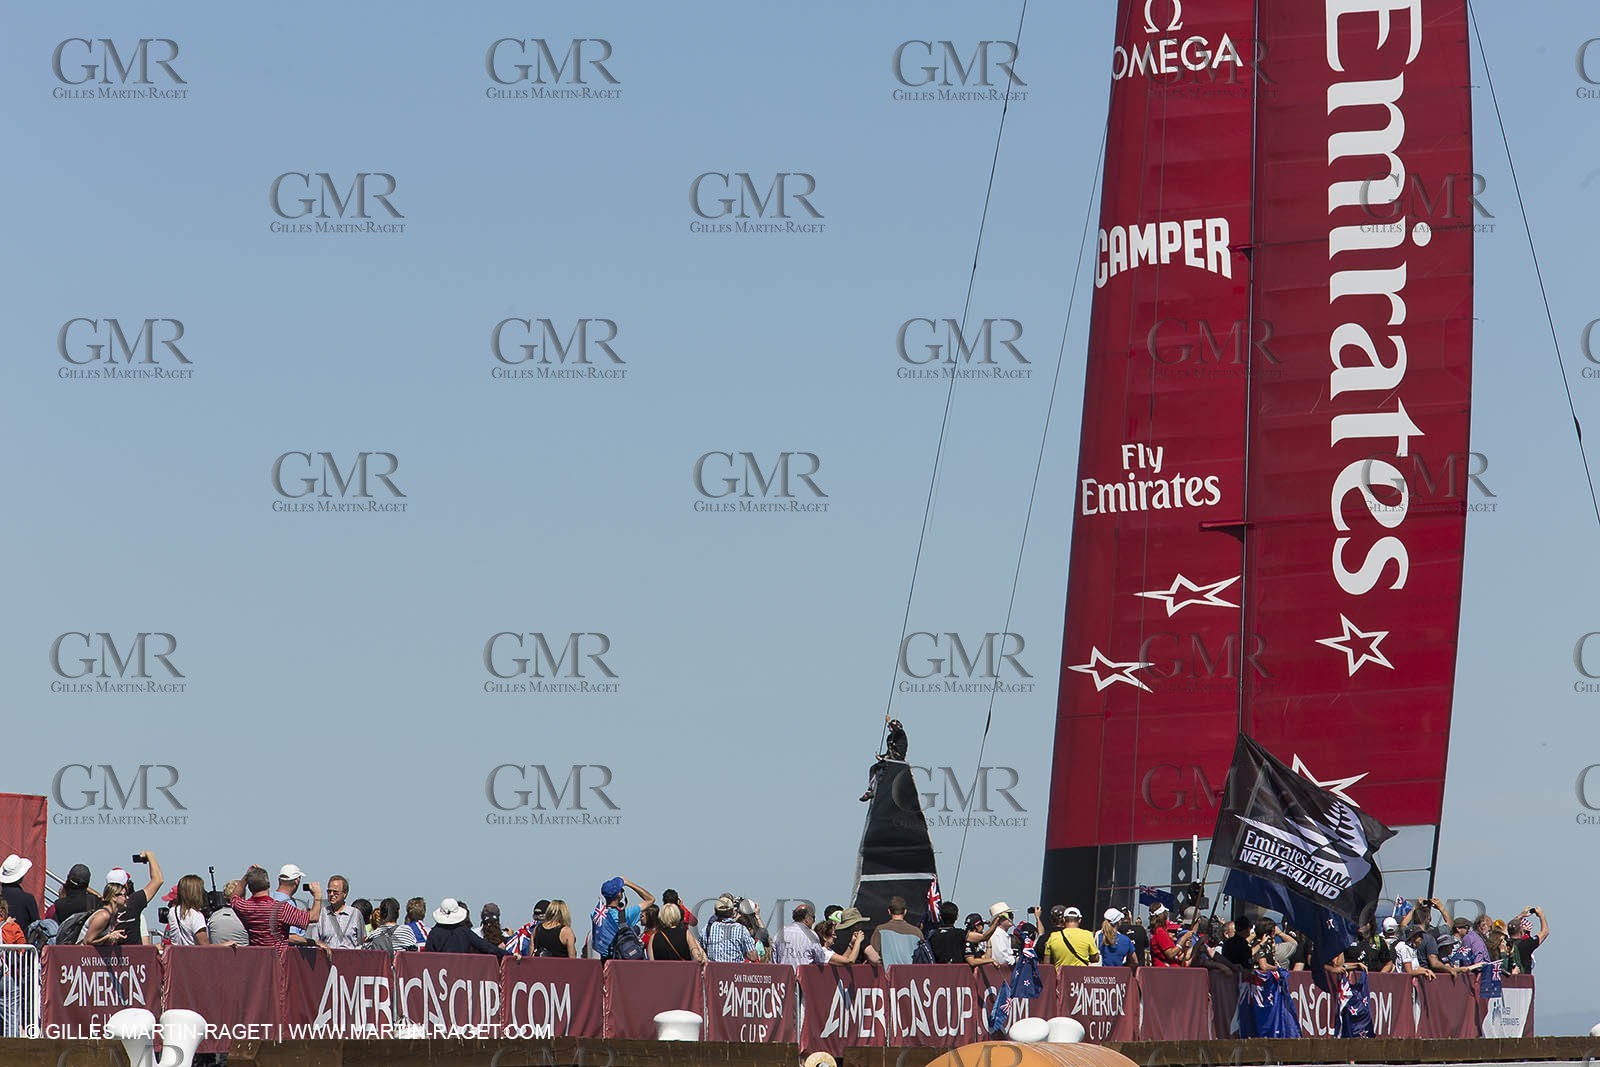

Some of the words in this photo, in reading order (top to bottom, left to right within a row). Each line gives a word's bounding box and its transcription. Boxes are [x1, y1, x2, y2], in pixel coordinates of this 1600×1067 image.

[1112, 33, 1243, 80] OMEGA
[1095, 217, 1232, 288] CAMPER
[1325, 0, 1432, 595] Emirates
[1121, 443, 1163, 473] Fly
[1081, 472, 1221, 515] Emirates
[1244, 829, 1308, 867] Emirates
[1240, 848, 1280, 870] NEW
[1276, 861, 1341, 900] ZEALAND
[60, 965, 74, 984] 34
[64, 964, 146, 1007] AMERICA'S
[719, 980, 728, 997] 34
[1070, 982, 1079, 998] 34
[722, 981, 786, 1018] AMERICA'S
[1071, 983, 1126, 1016] AMERICA'S
[740, 1023, 767, 1043] CUP
[1089, 1021, 1112, 1040] CUP
